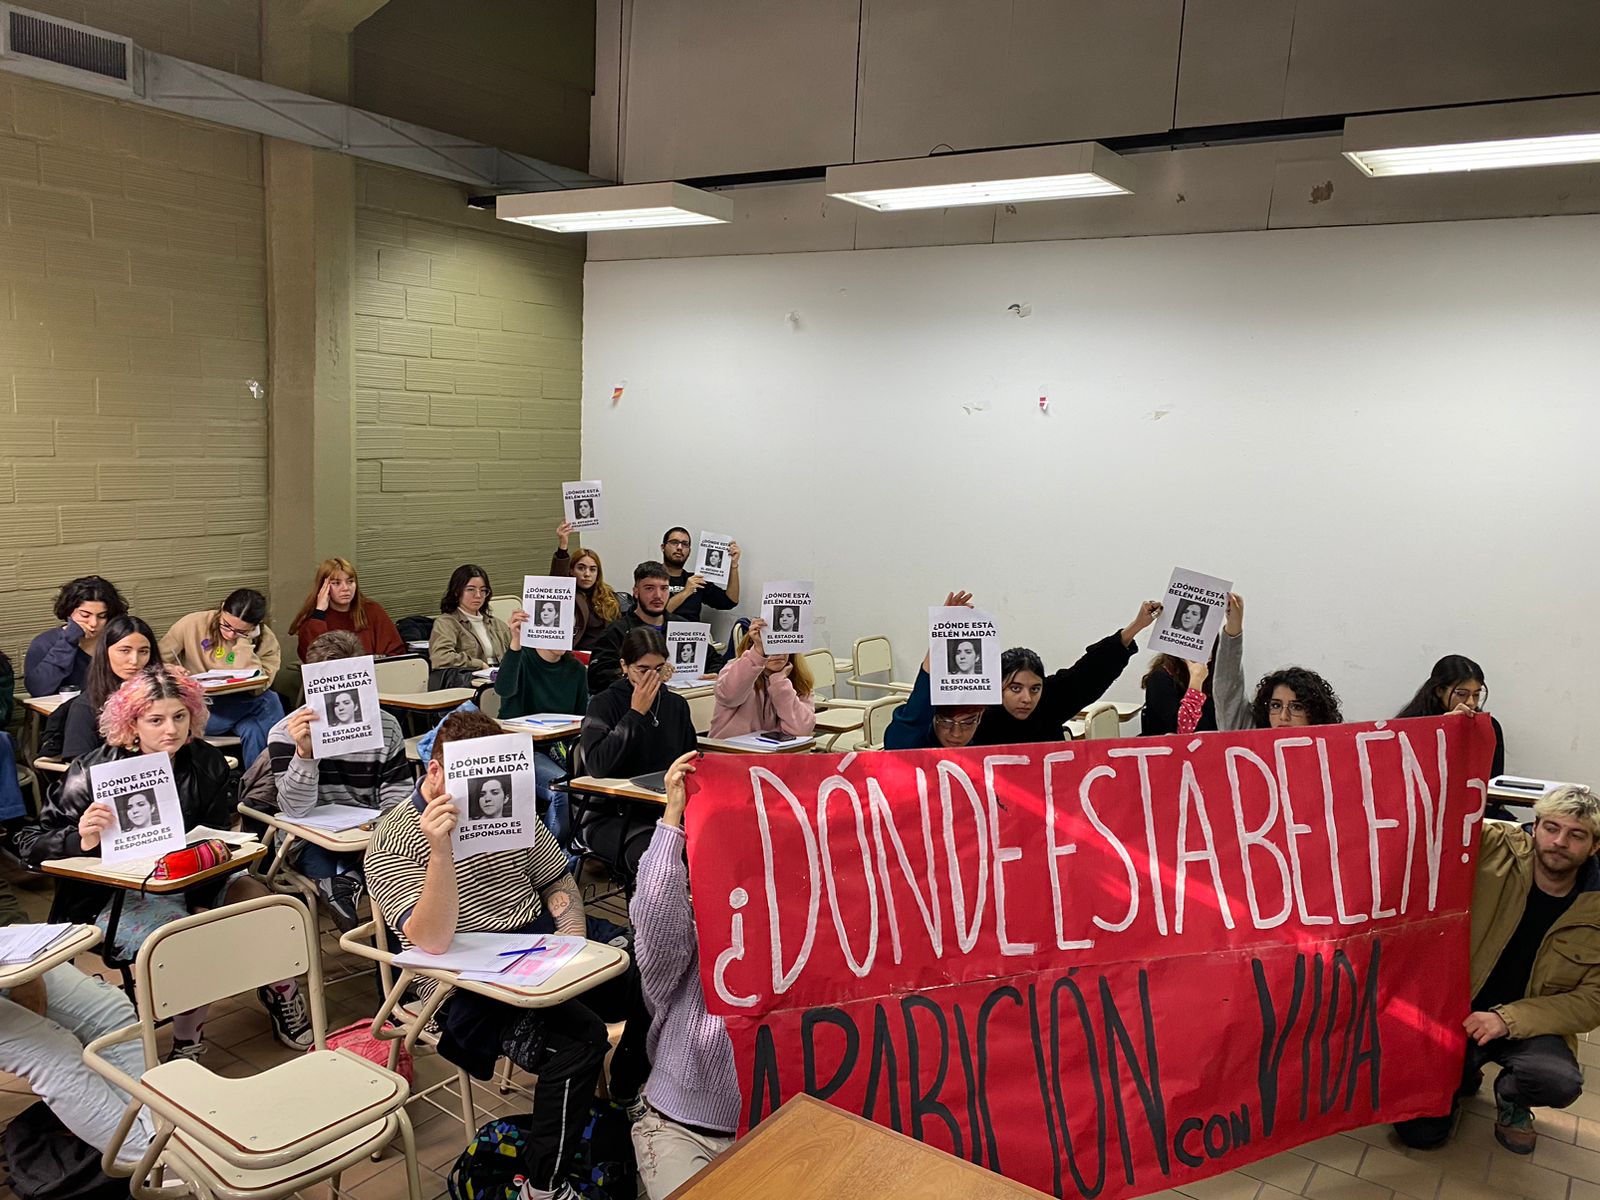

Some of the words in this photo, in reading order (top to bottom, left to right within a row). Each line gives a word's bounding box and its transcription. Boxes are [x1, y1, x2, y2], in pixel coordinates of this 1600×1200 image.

[1168, 588, 1193, 599] BELÉN
[1195, 595, 1224, 607] MAIDA?
[1172, 582, 1204, 594] ¿DÓNDE
[1206, 590, 1224, 600] ESTÁ
[933, 622, 969, 630] ¿DÓNDE
[1160, 636, 1203, 650] RESPONSABLE
[1171, 632, 1195, 642] ESTADO
[308, 683, 335, 694] BELÉN
[338, 679, 372, 689] MAIDA?
[309, 675, 345, 687] ¿DÓNDE
[347, 670, 369, 680] ESTÁ
[322, 731, 372, 744] RESPONSABLE
[333, 727, 360, 736] ESTADO
[450, 756, 496, 770] ¿DÓNDE
[499, 751, 526, 762] ESTÁ
[97, 775, 137, 791] ¿DÓNDE
[140, 768, 166, 780] ESTÁ
[448, 767, 483, 780] BELÉN
[487, 763, 529, 774] MAIDA?
[96, 785, 127, 799] BELÉN
[130, 777, 169, 791] MAIDA?
[460, 828, 522, 841] RESPONSABLE
[473, 822, 508, 830] ESTADO
[114, 833, 173, 851] RESPONSABLE
[127, 830, 159, 841] ESTADO
[713, 752, 1036, 1008] ¿DÓNDE
[1044, 738, 1236, 949] ESTÁ
[1174, 1104, 1250, 1168] CON
[1252, 938, 1381, 1137] VIDA
